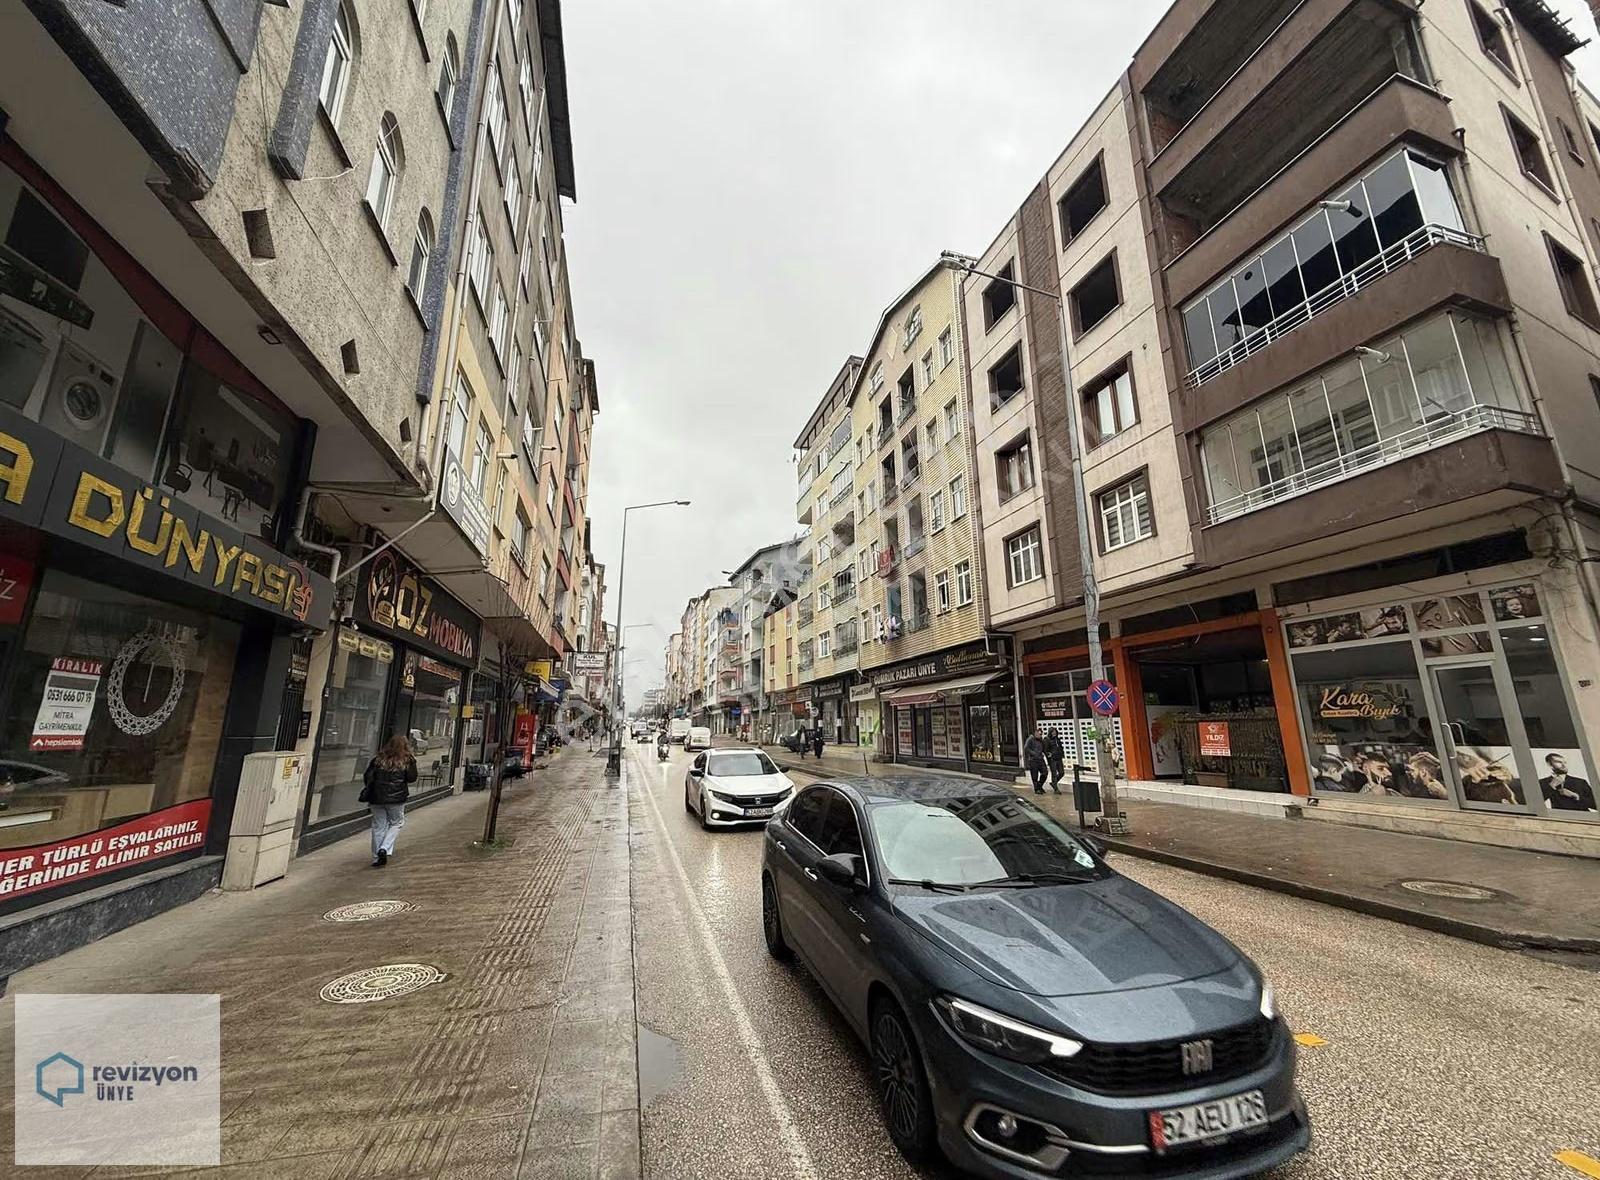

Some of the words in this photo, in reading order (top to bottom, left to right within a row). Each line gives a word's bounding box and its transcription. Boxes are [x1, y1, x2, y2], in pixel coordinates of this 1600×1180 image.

[68, 471, 298, 613] DÜNYASI
[895, 666, 917, 681] PAZARI
[917, 662, 936, 677] ÜNYE
[1320, 686, 1373, 710] Kara
[42, 838, 103, 866] TÜRLÜ
[108, 820, 199, 850] EŞYALARINIZ
[95, 849, 149, 870] ALINIR
[154, 832, 202, 854] SATILIR
